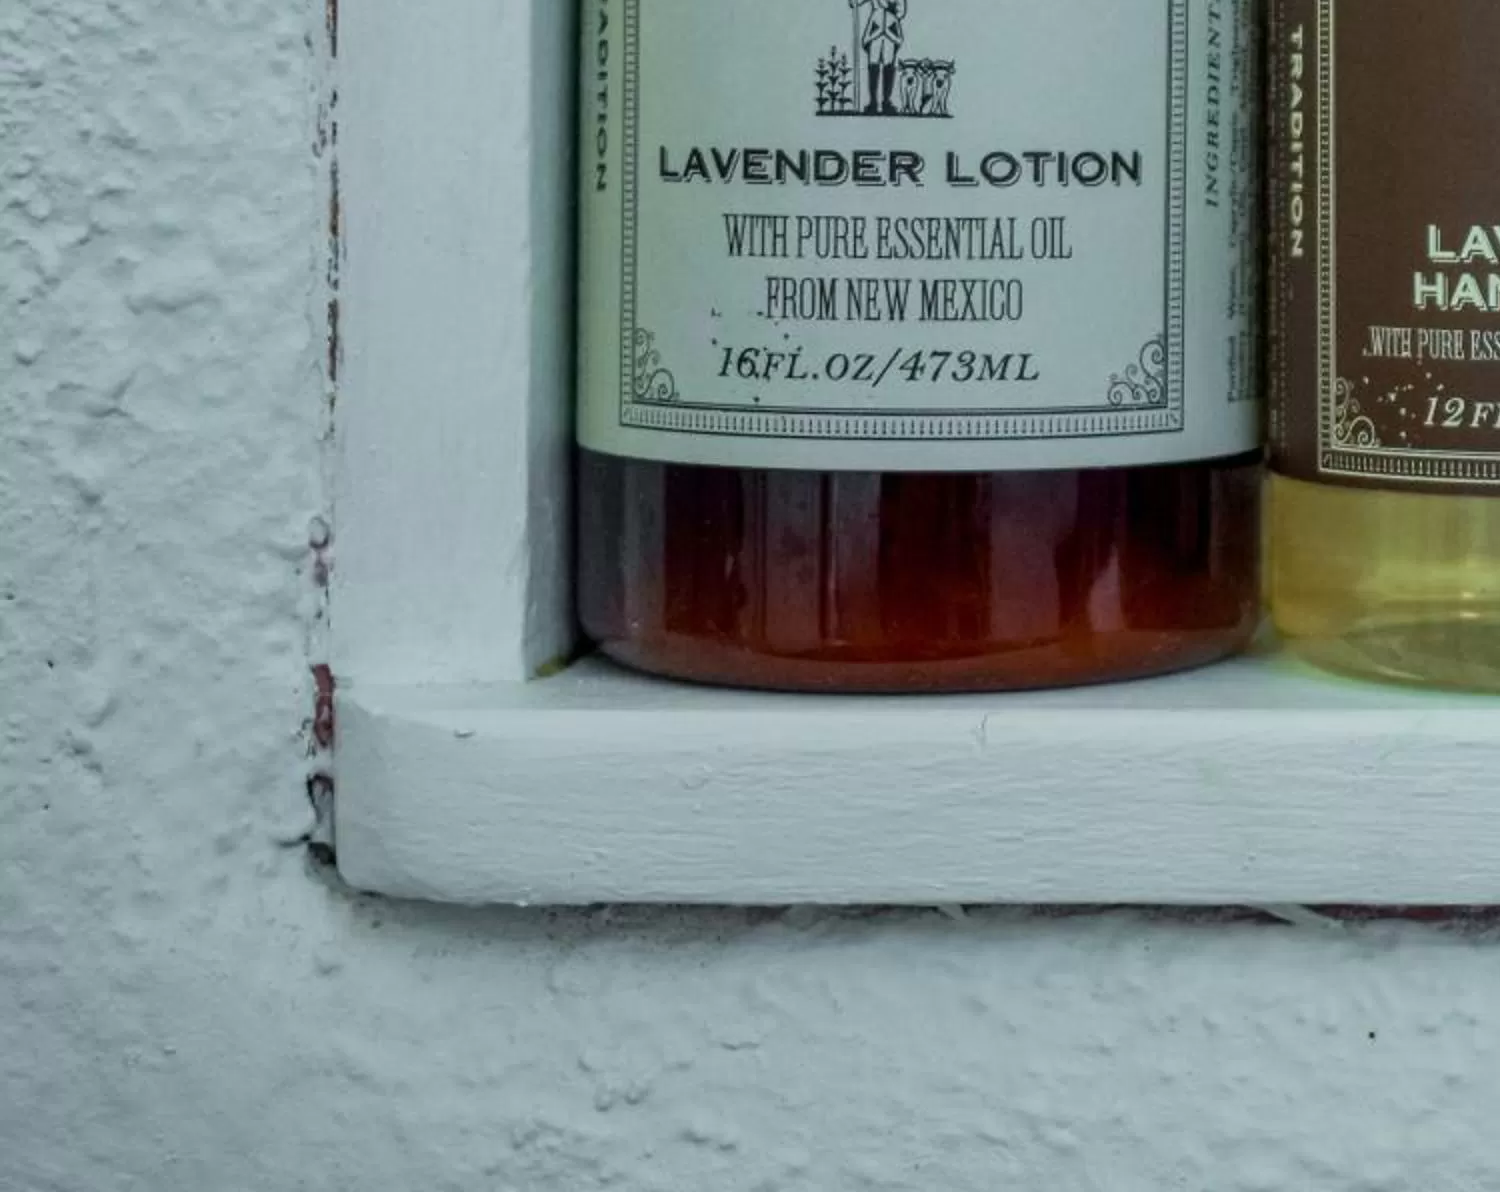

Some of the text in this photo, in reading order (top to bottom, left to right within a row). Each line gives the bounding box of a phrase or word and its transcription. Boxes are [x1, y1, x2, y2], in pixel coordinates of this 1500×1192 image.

[1290, 23, 1303, 258] TRADITION
[658, 146, 1142, 188] LAVENDER LOTION
[723, 213, 1073, 260] WITH PURE ESSENTIAL OIL
[765, 276, 1024, 321] FROM NEW MEXICO
[1368, 326, 1412, 358] WITH
[1416, 328, 1465, 360] PURE
